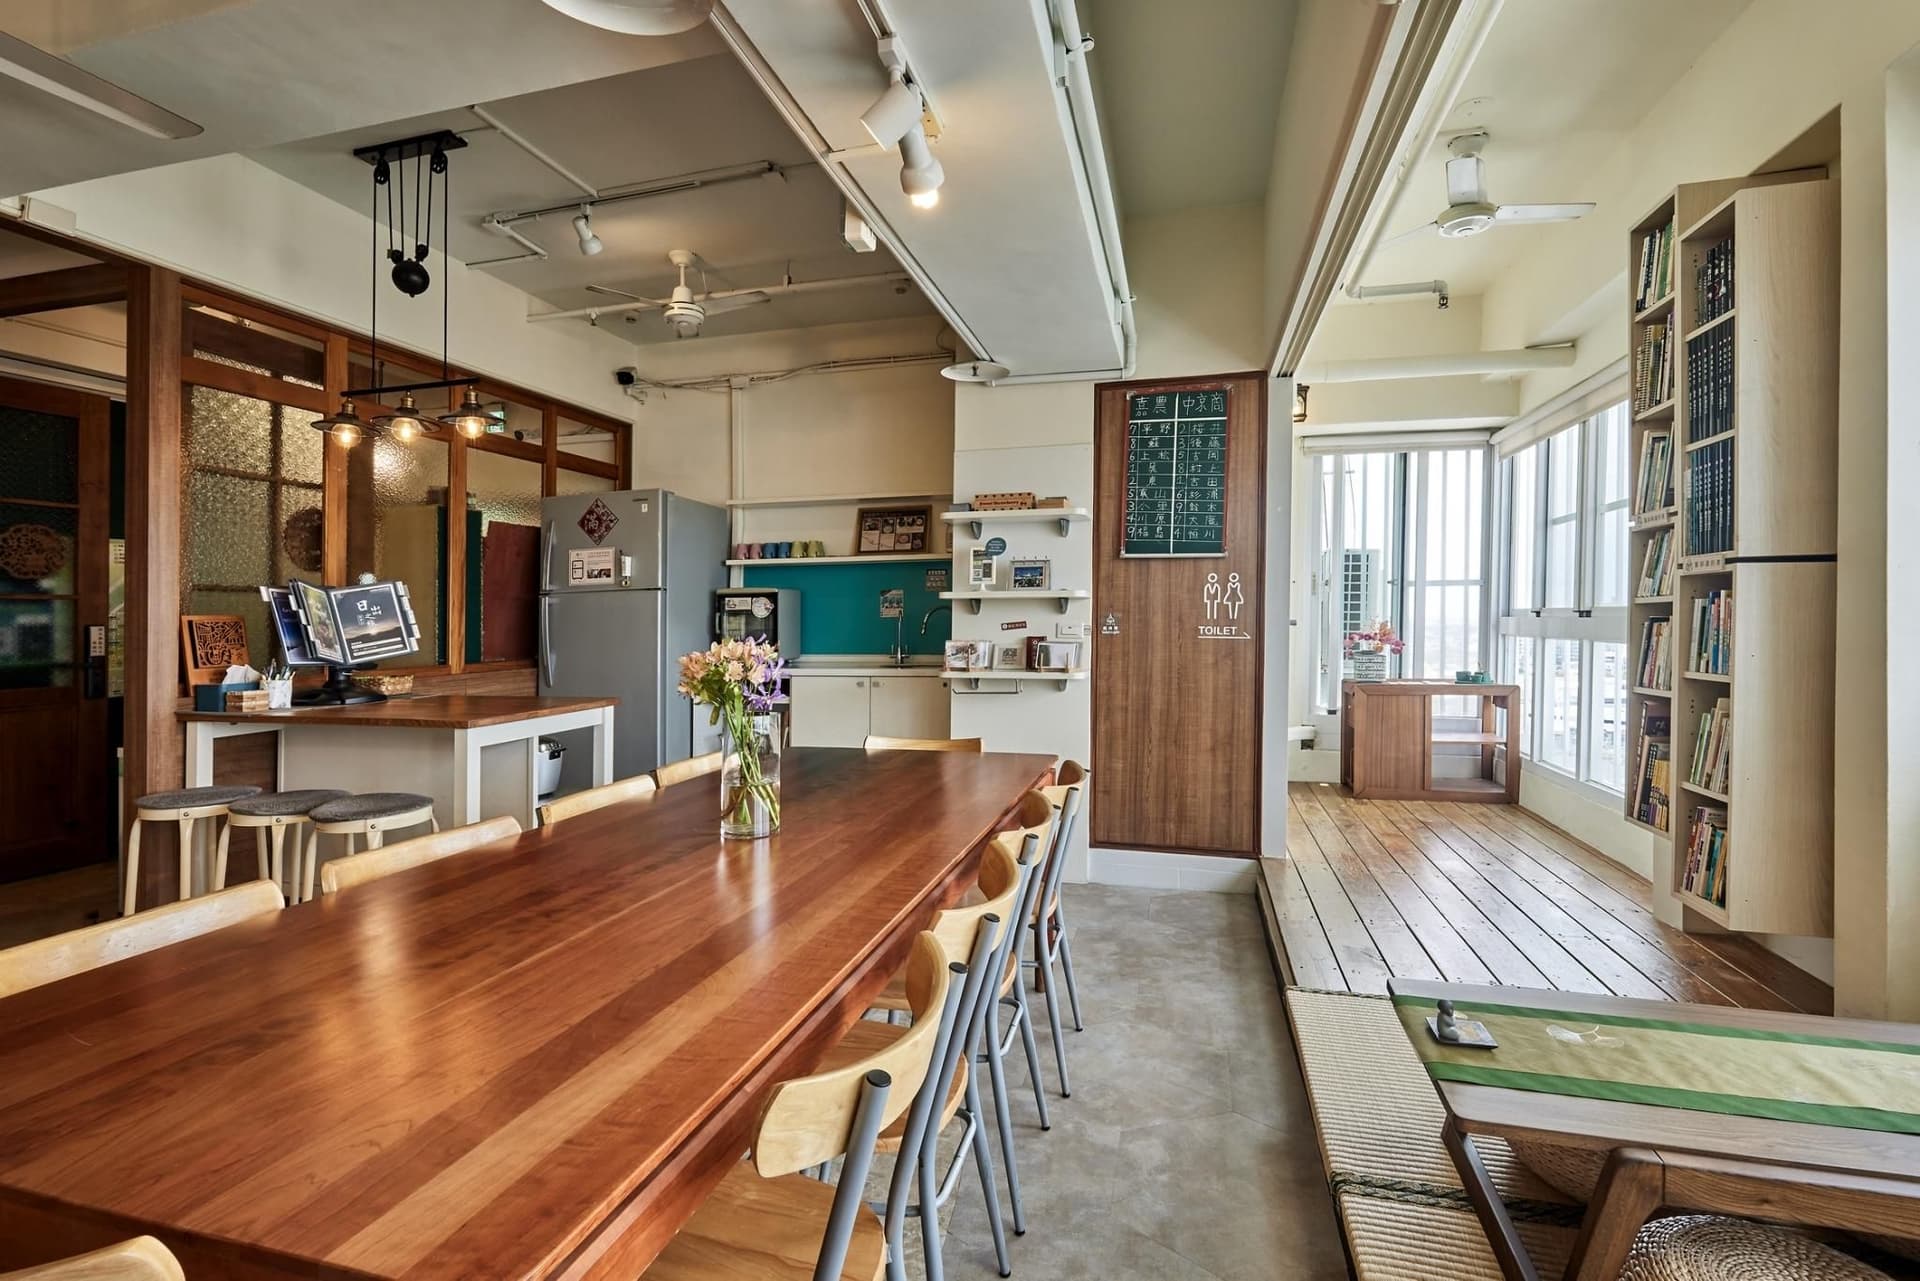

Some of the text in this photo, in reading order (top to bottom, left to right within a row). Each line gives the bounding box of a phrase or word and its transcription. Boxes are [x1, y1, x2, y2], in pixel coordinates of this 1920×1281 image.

[1182, 391, 1224, 416] 中京商
[1198, 625, 1238, 636] TOILET
